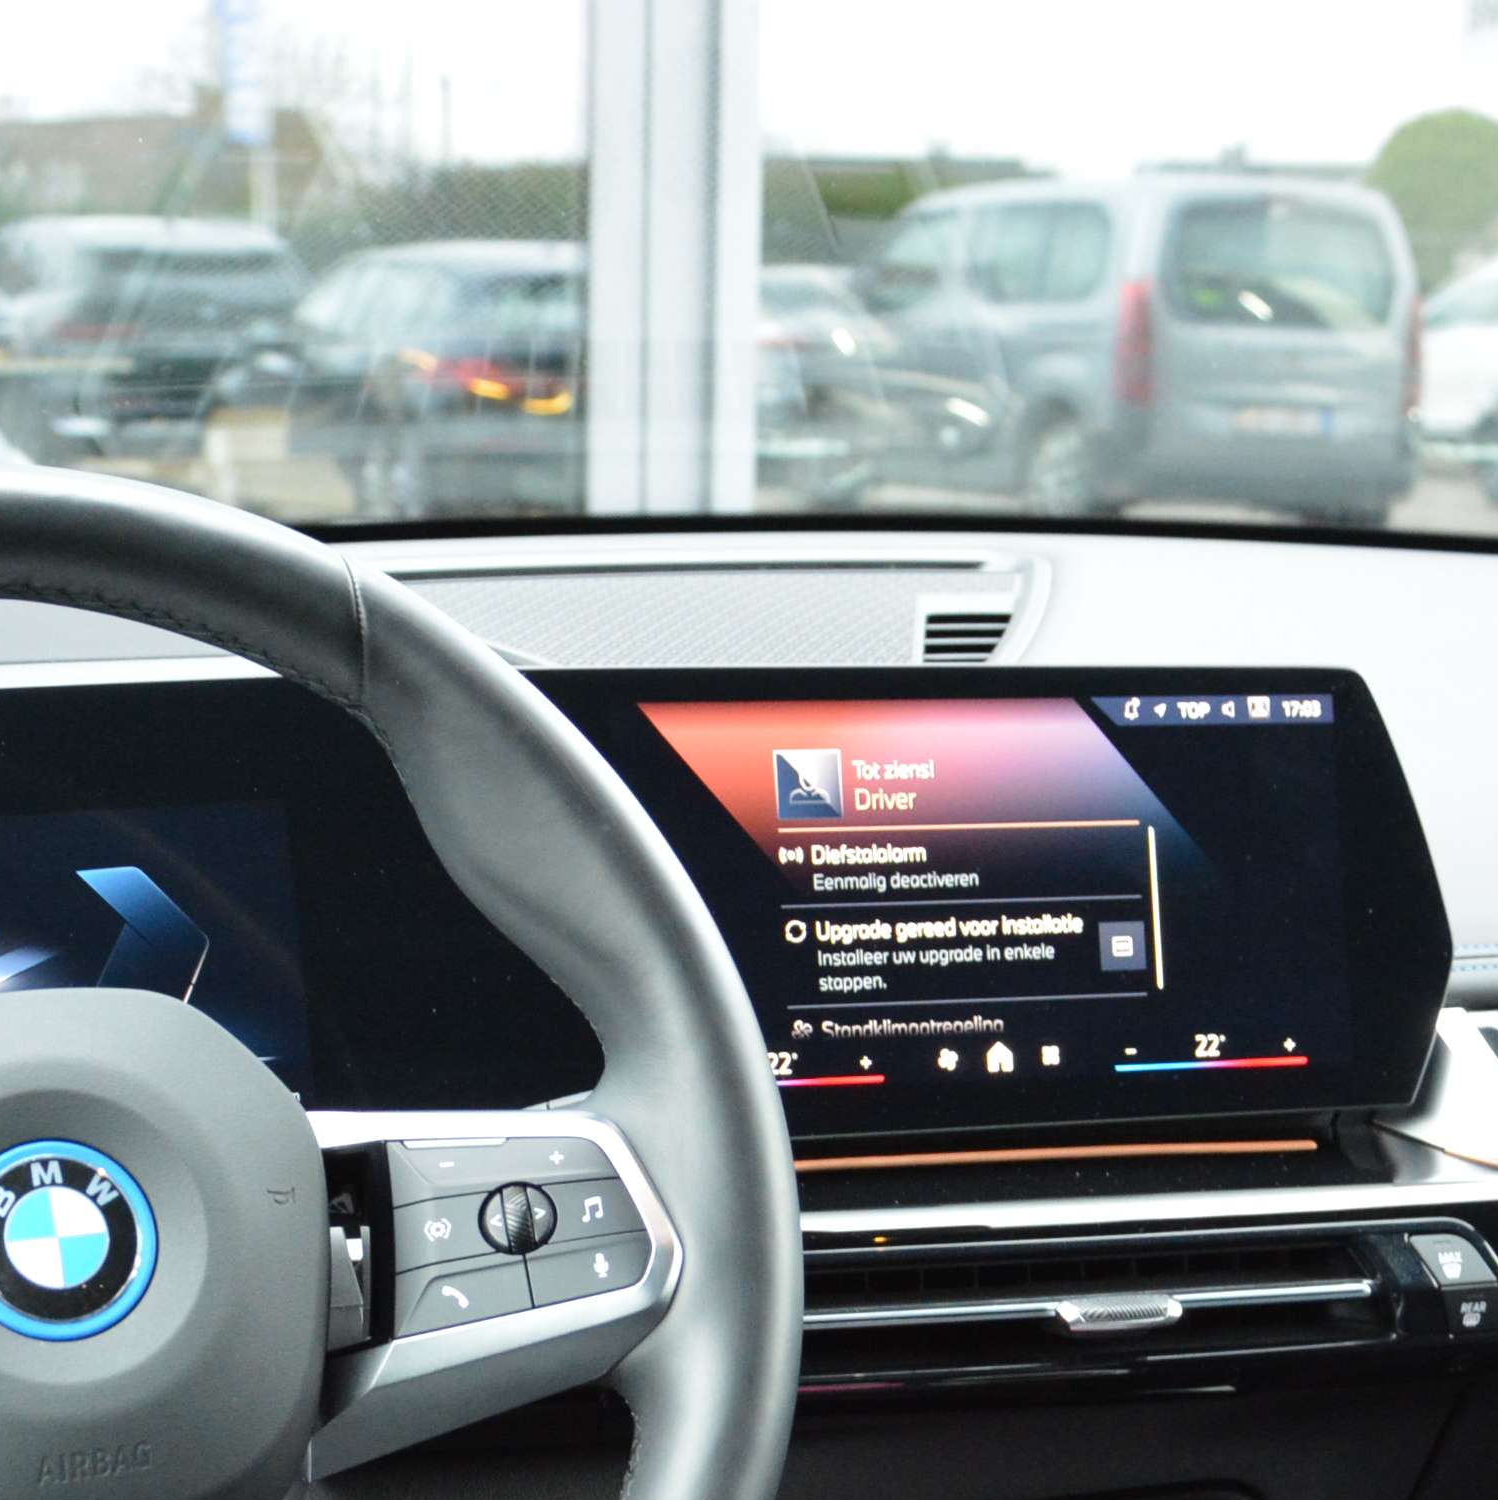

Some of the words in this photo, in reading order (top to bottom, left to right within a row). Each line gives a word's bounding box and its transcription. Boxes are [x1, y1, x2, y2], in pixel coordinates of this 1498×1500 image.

[1177, 701, 1211, 720] TOP
[1281, 699, 1322, 719] 17:03
[851, 759, 881, 780] Tot
[854, 787, 917, 812] Driver
[810, 842, 928, 865] Diefstalalarm
[813, 872, 887, 893] Eenmalig
[890, 870, 980, 889] deactiveren
[815, 919, 892, 945] Upgrade
[895, 917, 957, 943] gereed
[959, 918, 999, 937] voor
[1001, 913, 1084, 936] installatie
[817, 948, 890, 967] Installeer
[892, 948, 916, 964] uw
[919, 945, 983, 967] upgrade
[986, 943, 1001, 961] in
[1003, 942, 1055, 961] enkele
[818, 973, 888, 994] stappen.
[38, 1441, 153, 1487] AIRBAG
